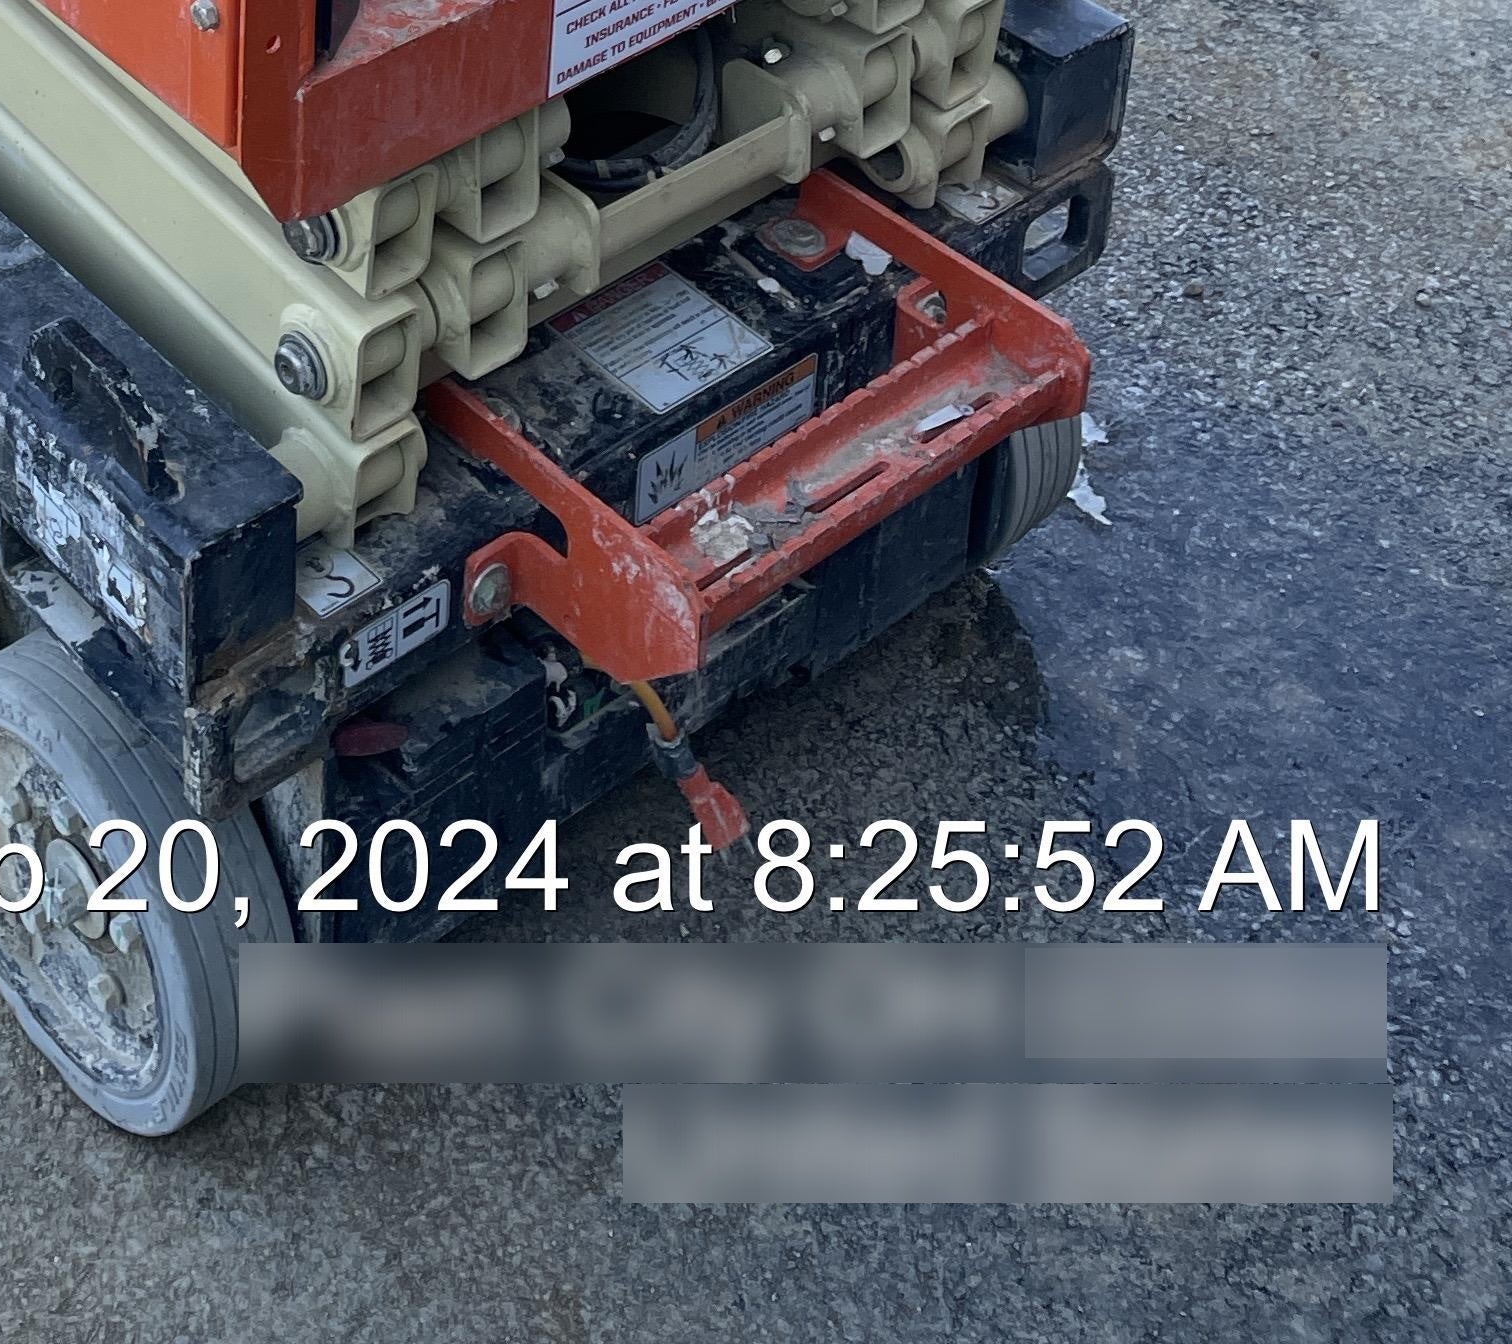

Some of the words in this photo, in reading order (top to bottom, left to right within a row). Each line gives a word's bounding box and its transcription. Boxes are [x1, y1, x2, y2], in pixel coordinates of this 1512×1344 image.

[556, 48, 608, 85] DAMAGE
[610, 39, 626, 57] TO
[628, 1, 698, 49] EQUIPMENT
[566, 6, 606, 35] CHECK
[584, 3, 655, 49] INSURANCE
[732, 372, 795, 419] WARNING
